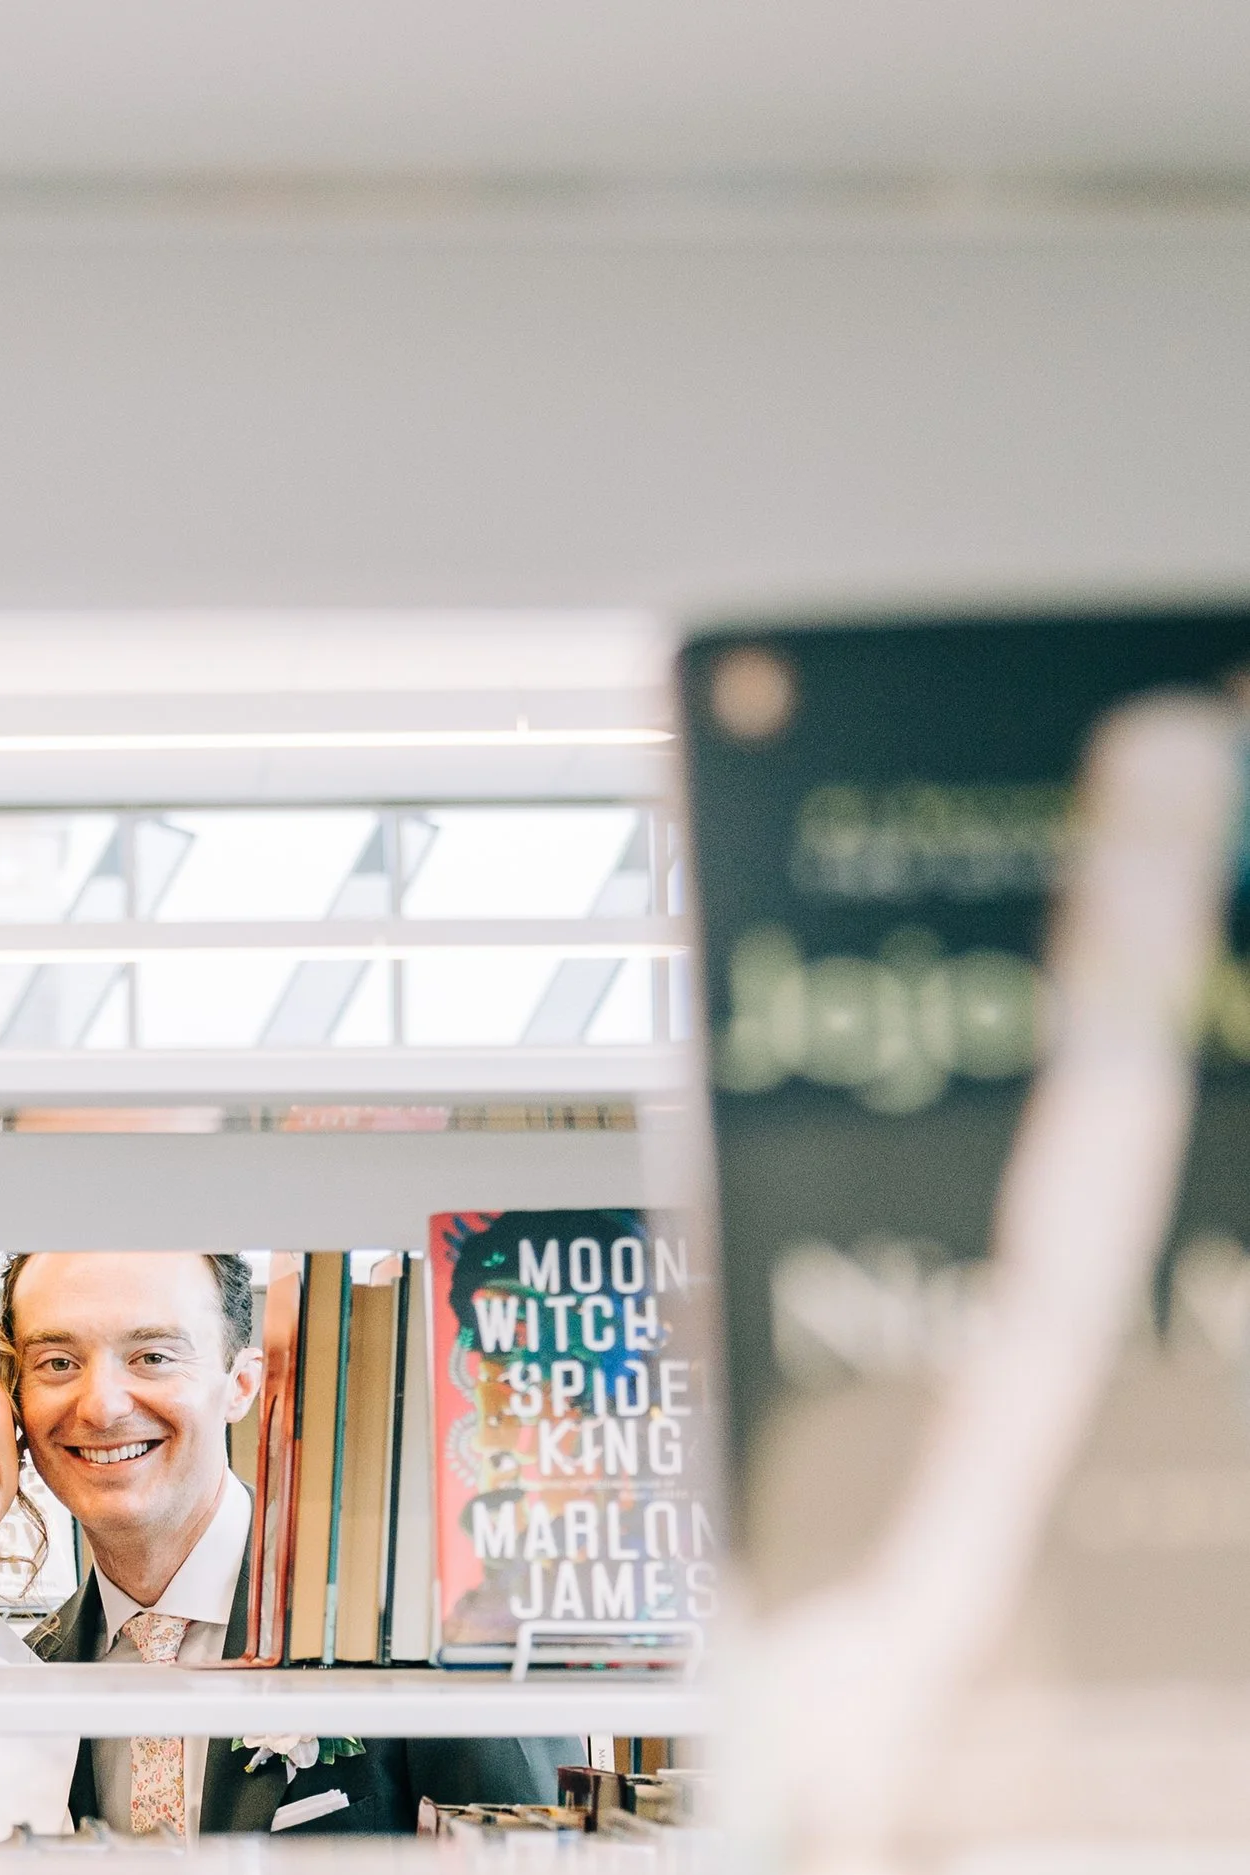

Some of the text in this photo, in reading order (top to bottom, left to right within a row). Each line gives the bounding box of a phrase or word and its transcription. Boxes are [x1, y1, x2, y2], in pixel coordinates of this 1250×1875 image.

[518, 1236, 688, 1294] MOON
[474, 1295, 659, 1352] WITCH
[508, 1360, 693, 1418] SPIDE
[537, 1418, 683, 1476] KING
[472, 1501, 717, 1559] MARLON
[510, 1561, 719, 1620] JAMES
